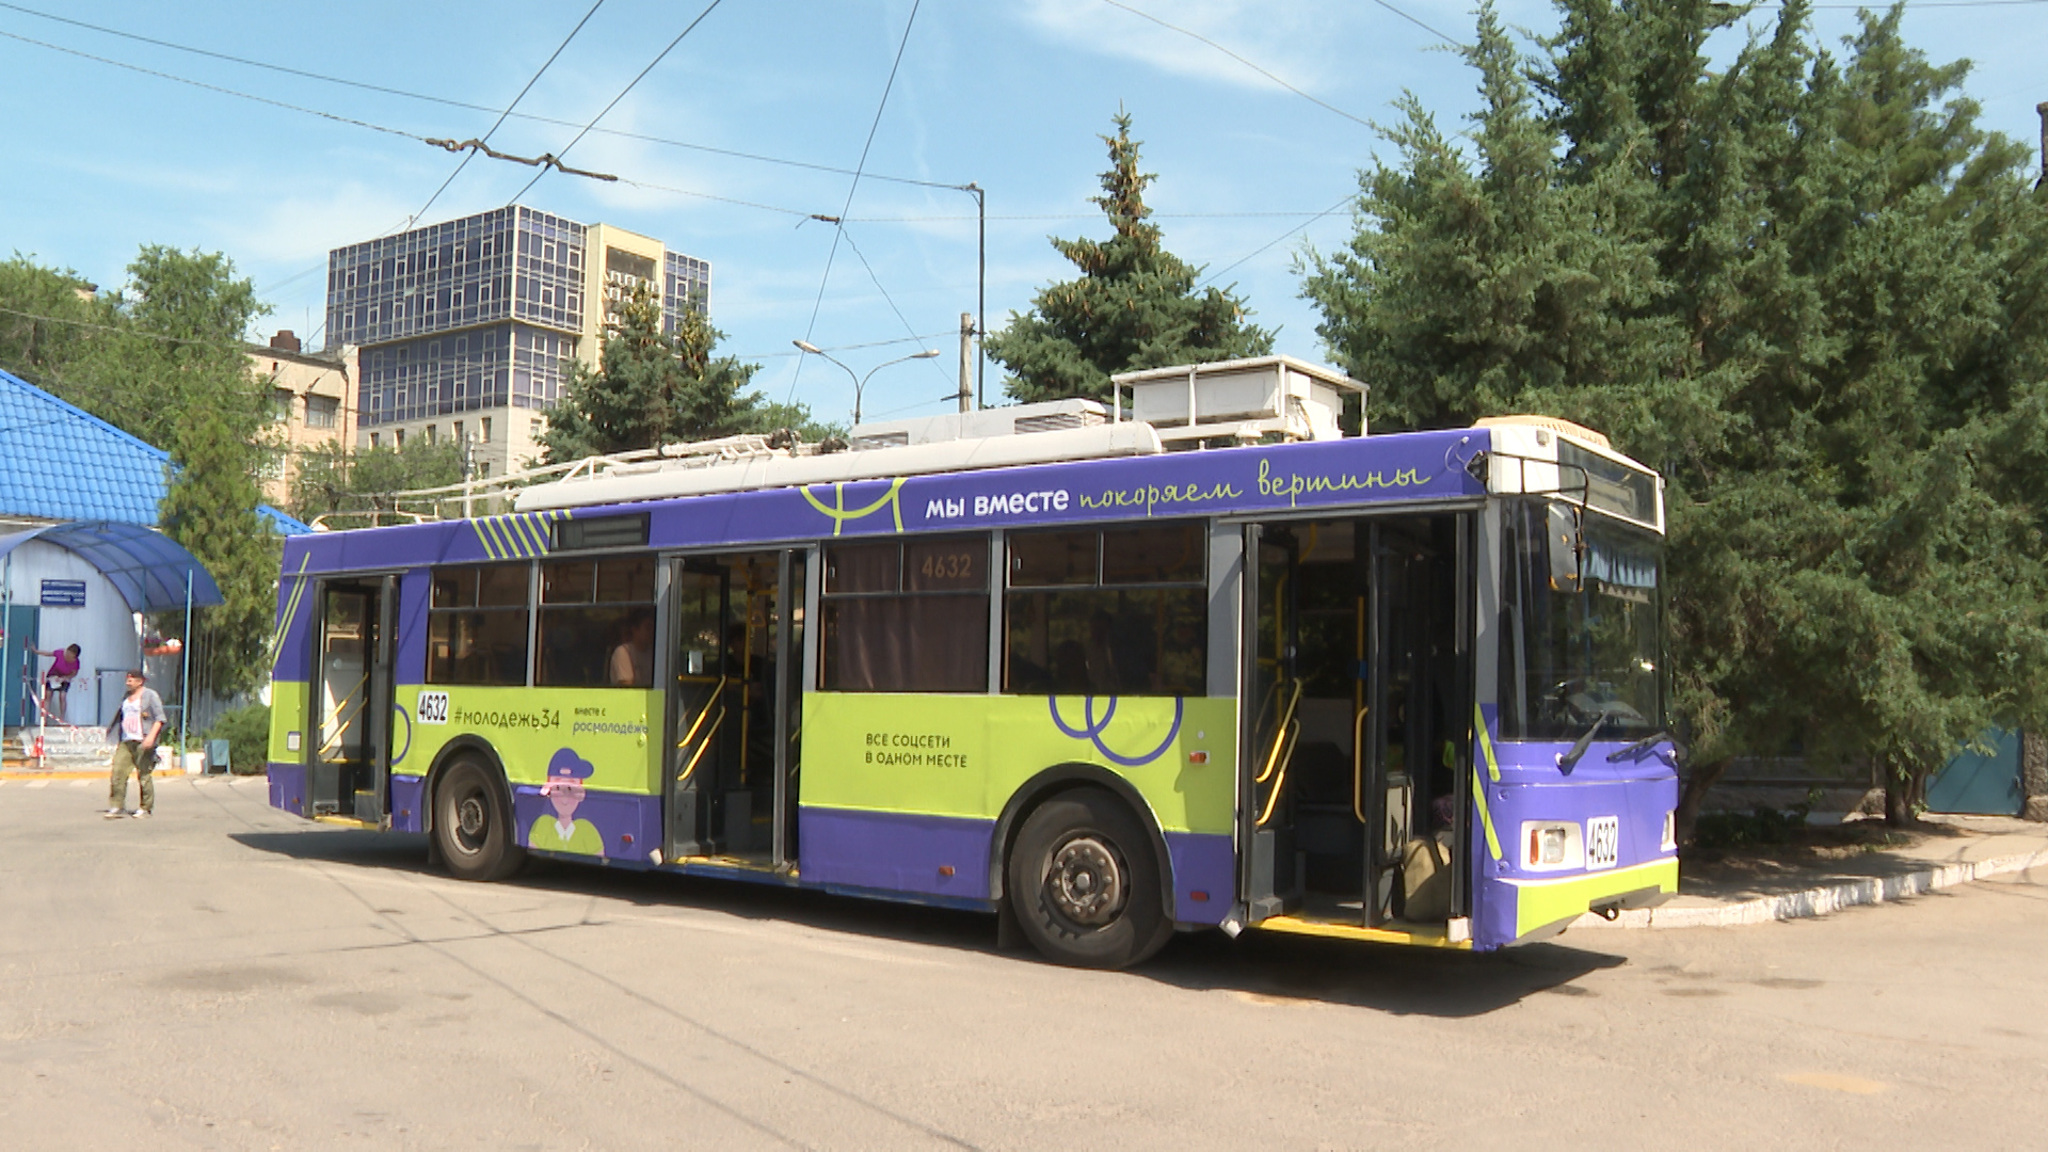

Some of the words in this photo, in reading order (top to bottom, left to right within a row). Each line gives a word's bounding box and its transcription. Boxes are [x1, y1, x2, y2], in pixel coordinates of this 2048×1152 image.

[925, 497, 965, 519] мы
[974, 489, 1070, 516] вместе
[1079, 481, 1244, 517] покоряем
[1257, 458, 1432, 508] вершины
[921, 553, 972, 579] 4632
[418, 694, 448, 721] 4632
[866, 733, 889, 746] ВСЕ
[892, 734, 950, 748] СОЦСЕТИ
[865, 751, 873, 764] В
[876, 752, 922, 766] ОДНОМ
[926, 754, 967, 768] МЕСТЕ
[1588, 821, 1616, 864] 4632
